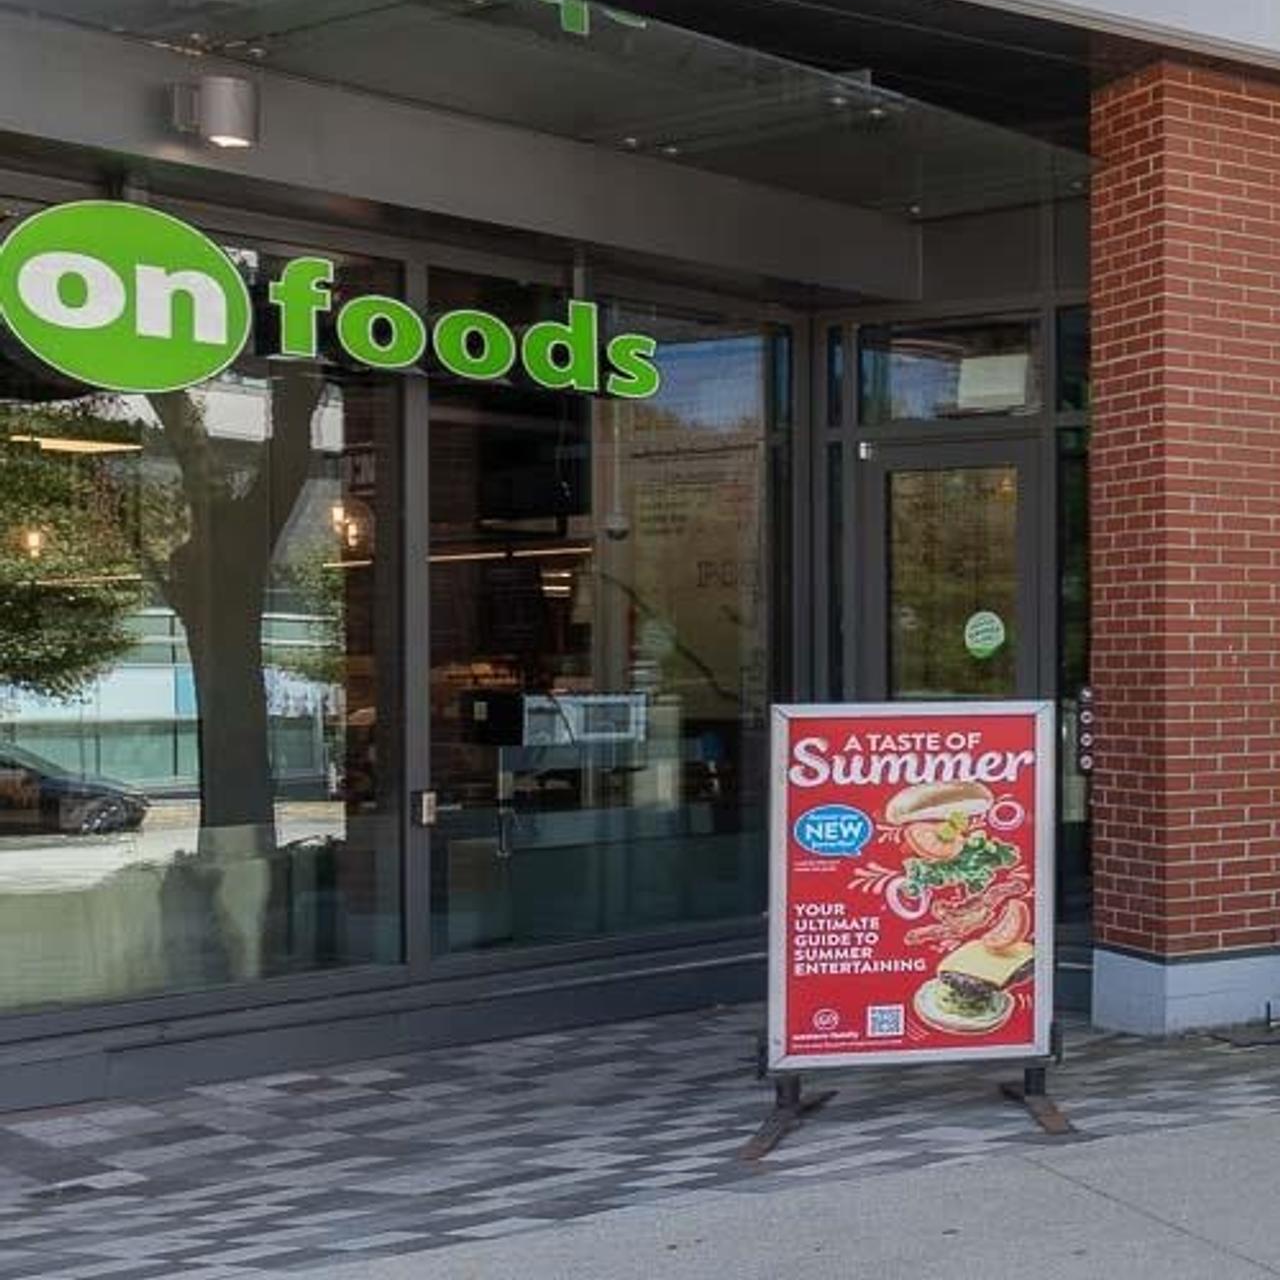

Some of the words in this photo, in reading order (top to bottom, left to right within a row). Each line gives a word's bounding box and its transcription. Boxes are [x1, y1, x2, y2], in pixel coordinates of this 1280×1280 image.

[16, 251, 228, 345] on
[268, 256, 662, 399] foods
[844, 735, 862, 752] A
[866, 733, 940, 752] TASTE
[946, 732, 982, 750] OF
[788, 736, 1035, 788] Summer
[805, 821, 863, 841] NEW
[795, 902, 846, 917] YOUR
[795, 917, 880, 933] ULTIMATE
[794, 933, 851, 947] GUIDE
[856, 931, 879, 945] TO
[794, 946, 874, 961] SUMMER
[795, 958, 927, 976] ENTERTAINING
